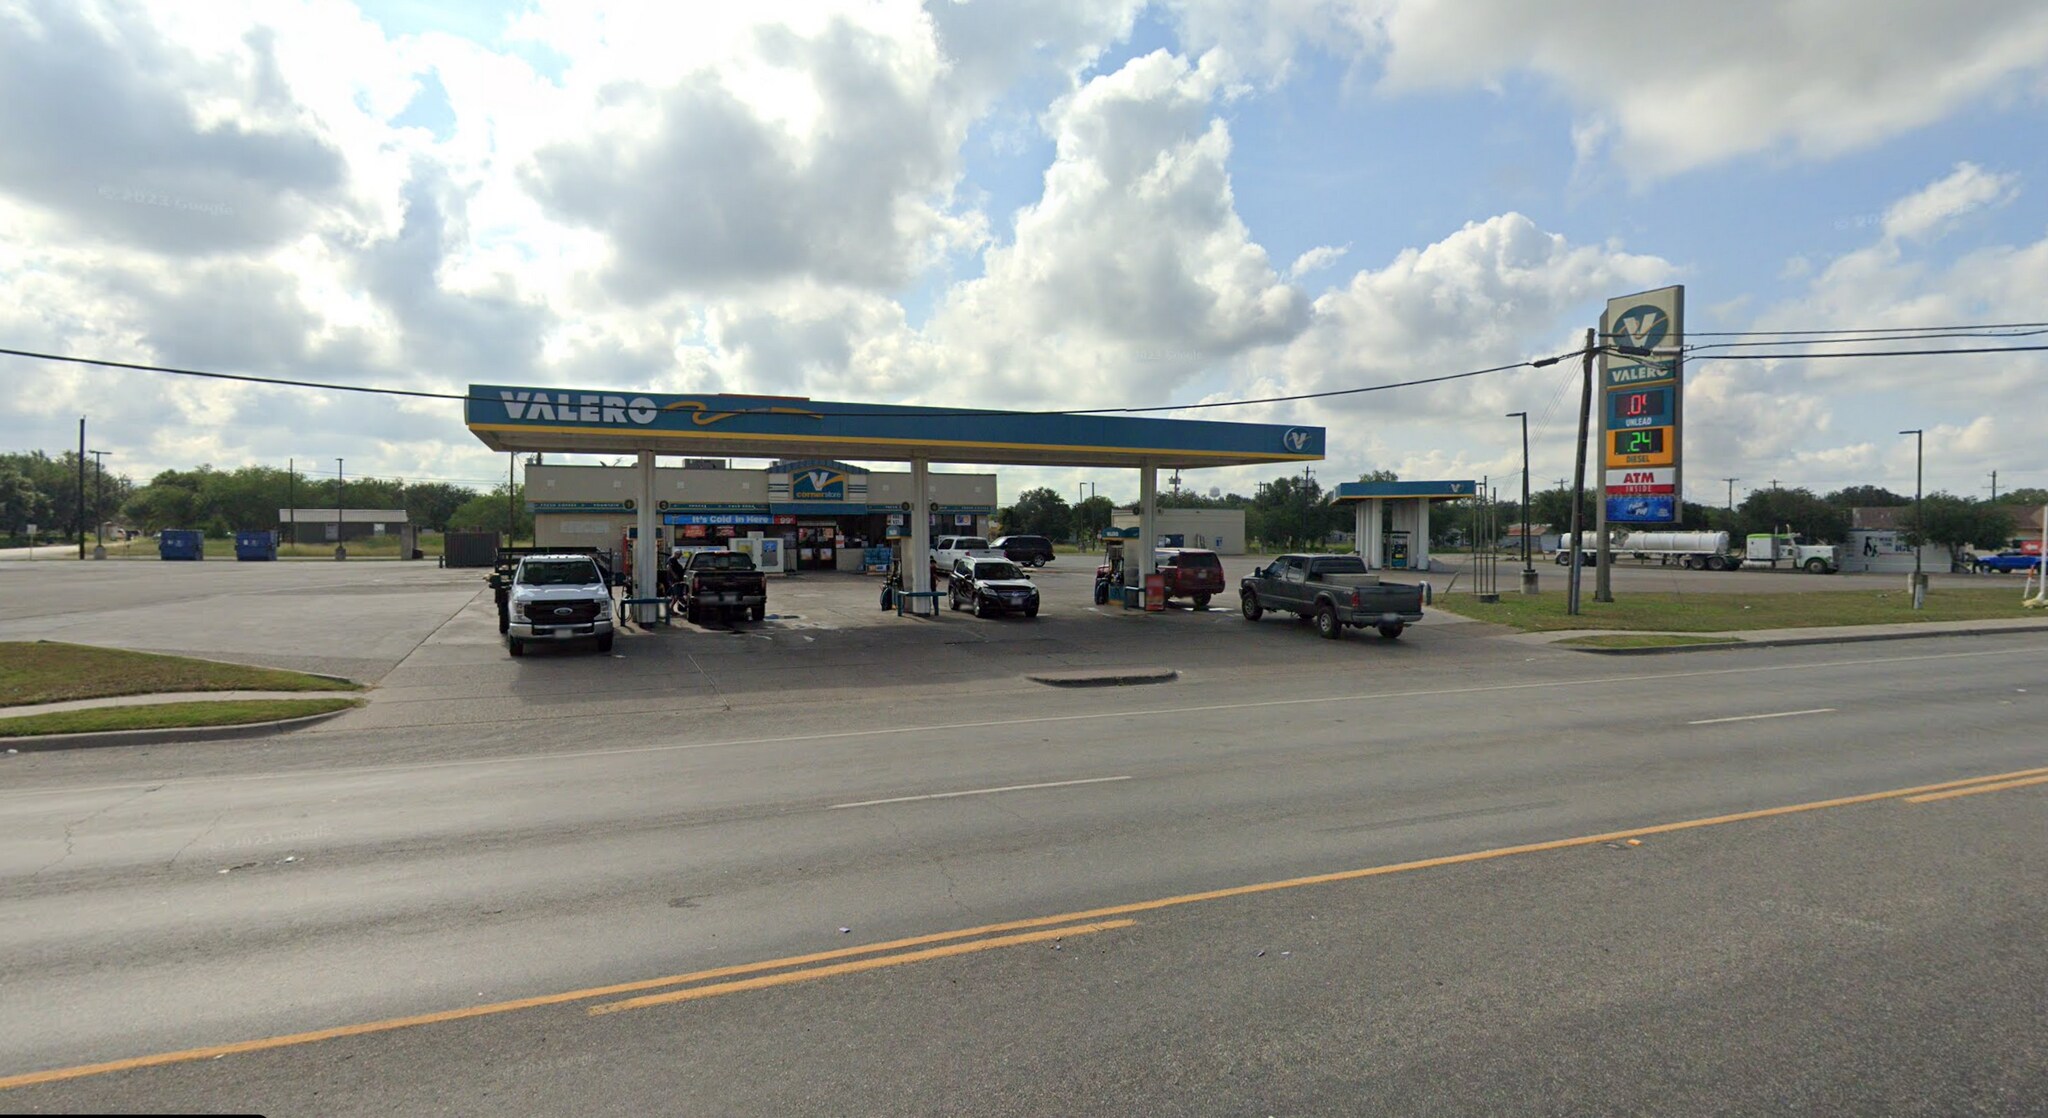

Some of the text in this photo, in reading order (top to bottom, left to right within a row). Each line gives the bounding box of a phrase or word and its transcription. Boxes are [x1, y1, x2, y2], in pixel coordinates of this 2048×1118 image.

[500, 391, 657, 424] VALERO
[1625, 417, 1652, 427] UNLEAD
[1626, 455, 1650, 463] DIESEL
[1624, 472, 1654, 483] ATM
[1625, 485, 1652, 493] INSIDE
[692, 515, 708, 524] It's
[710, 515, 731, 524] Cold
[750, 515, 769, 524] Here
